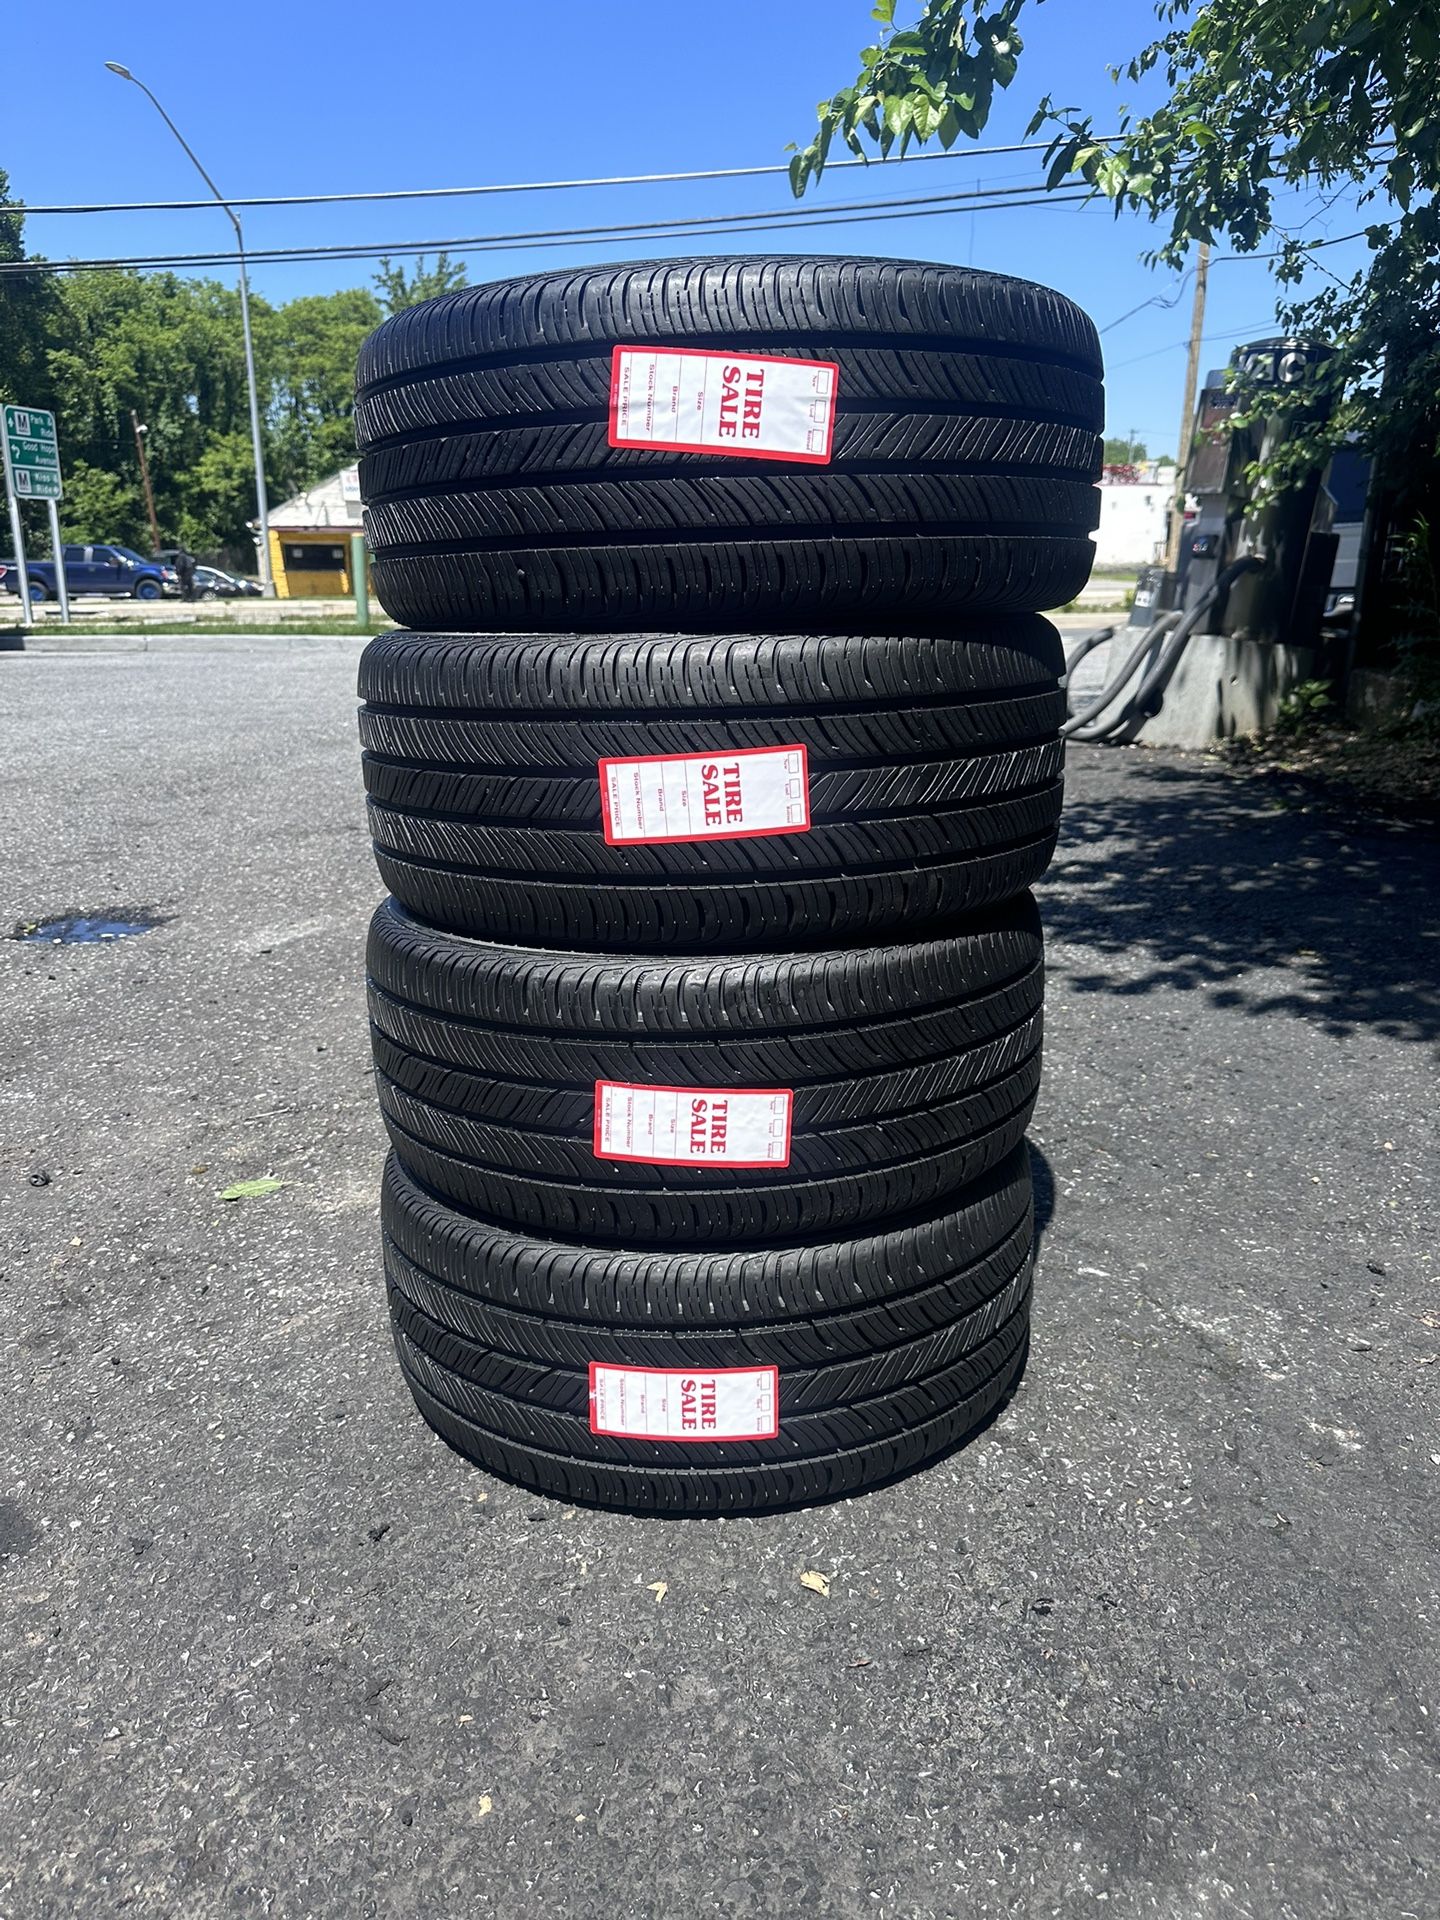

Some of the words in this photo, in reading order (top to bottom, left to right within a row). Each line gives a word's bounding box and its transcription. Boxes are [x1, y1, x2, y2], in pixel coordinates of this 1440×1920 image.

[30, 414, 44, 425] Park
[718, 365, 741, 438] SALE
[742, 368, 765, 439] TIRE
[22, 441, 38, 452] Good
[40, 428, 54, 438] Ride
[34, 472, 50, 482] Kiss
[36, 484, 52, 494] Ride
[701, 764, 722, 826] SALE
[723, 762, 743, 824] TIRE
[690, 1098, 707, 1154] SALE
[710, 1100, 728, 1154] TIRE
[681, 1379, 697, 1430] SALE
[701, 1379, 716, 1430] TIRE
